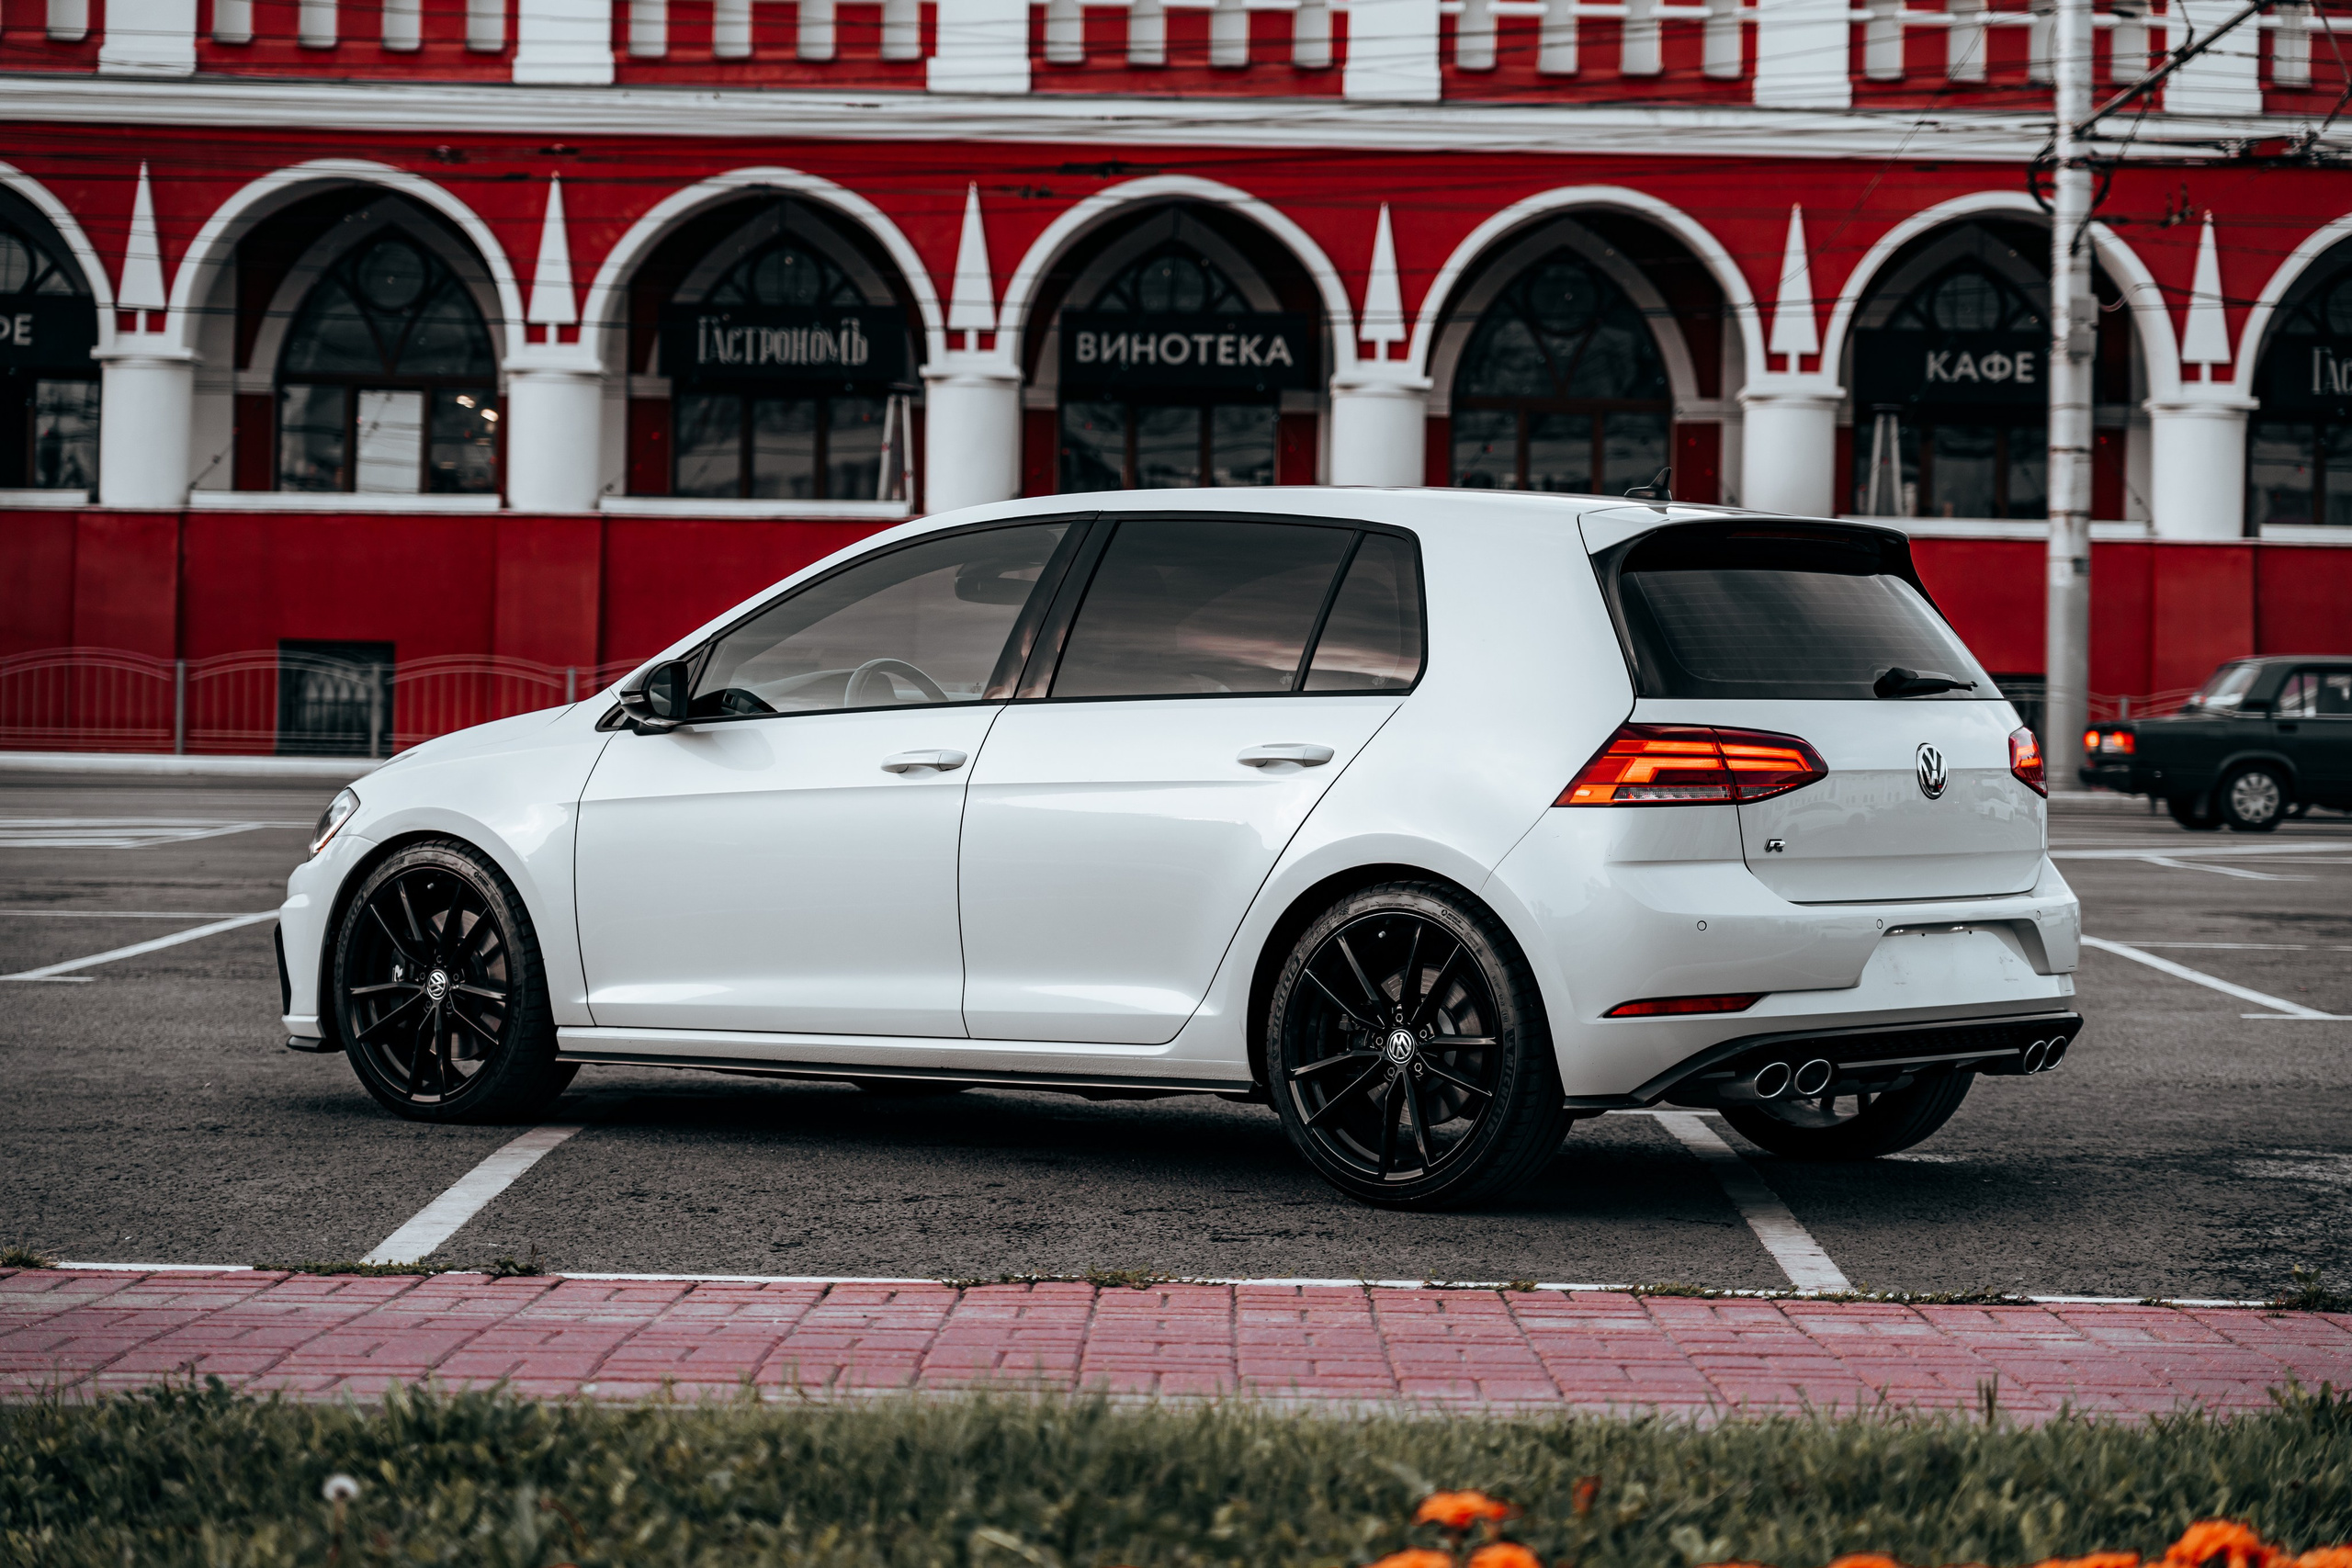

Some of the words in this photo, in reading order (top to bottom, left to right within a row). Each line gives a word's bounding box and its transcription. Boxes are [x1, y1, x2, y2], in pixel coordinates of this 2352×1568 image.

[1076, 332, 1293, 367] ВИНОТЕКА
[1926, 350, 2035, 383] КАФЕ
[1764, 838, 1786, 852] R
[1272, 961, 1298, 1039] MICHELIN
[1487, 1054, 1514, 1134] MICHELIN
